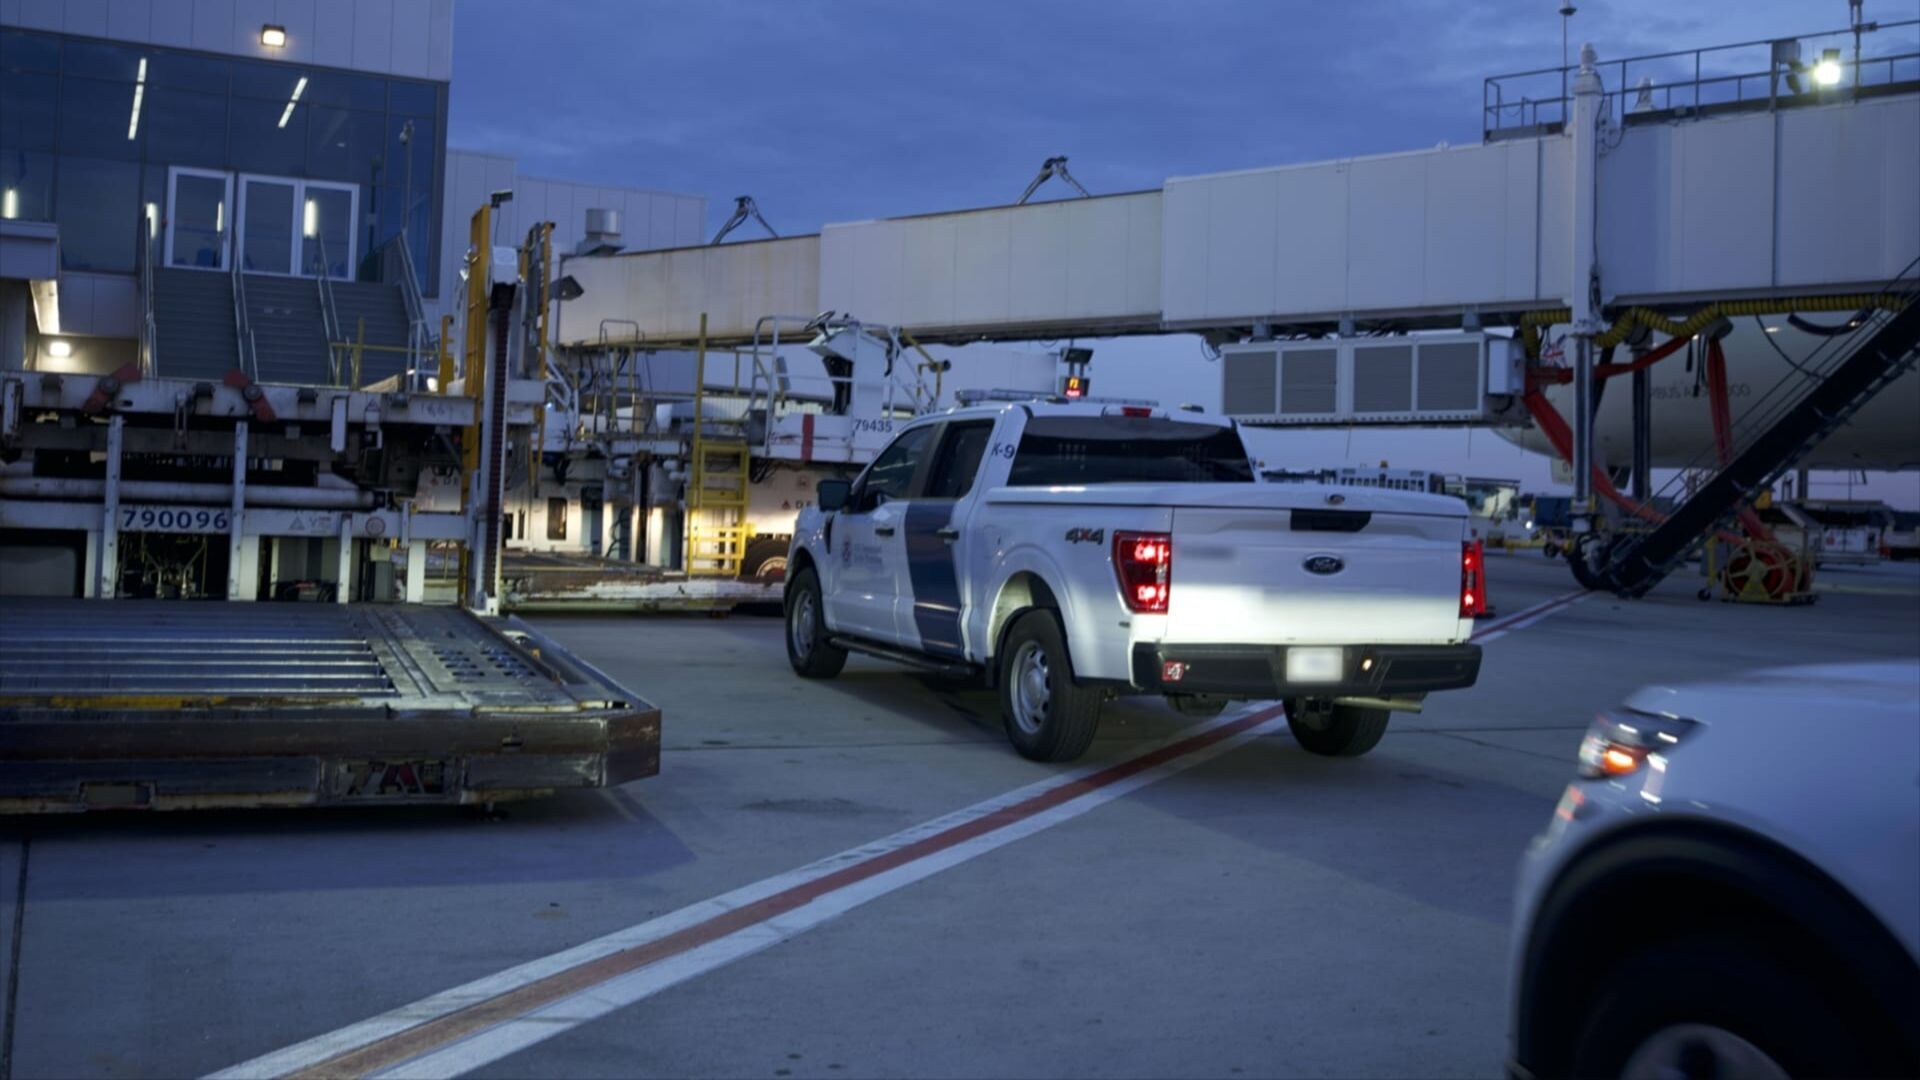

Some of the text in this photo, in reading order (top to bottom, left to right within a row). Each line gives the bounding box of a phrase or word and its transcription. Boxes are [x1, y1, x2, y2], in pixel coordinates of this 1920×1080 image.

[855, 418, 893, 433] 79435
[991, 441, 1016, 460] K-9
[122, 509, 229, 529] 790096
